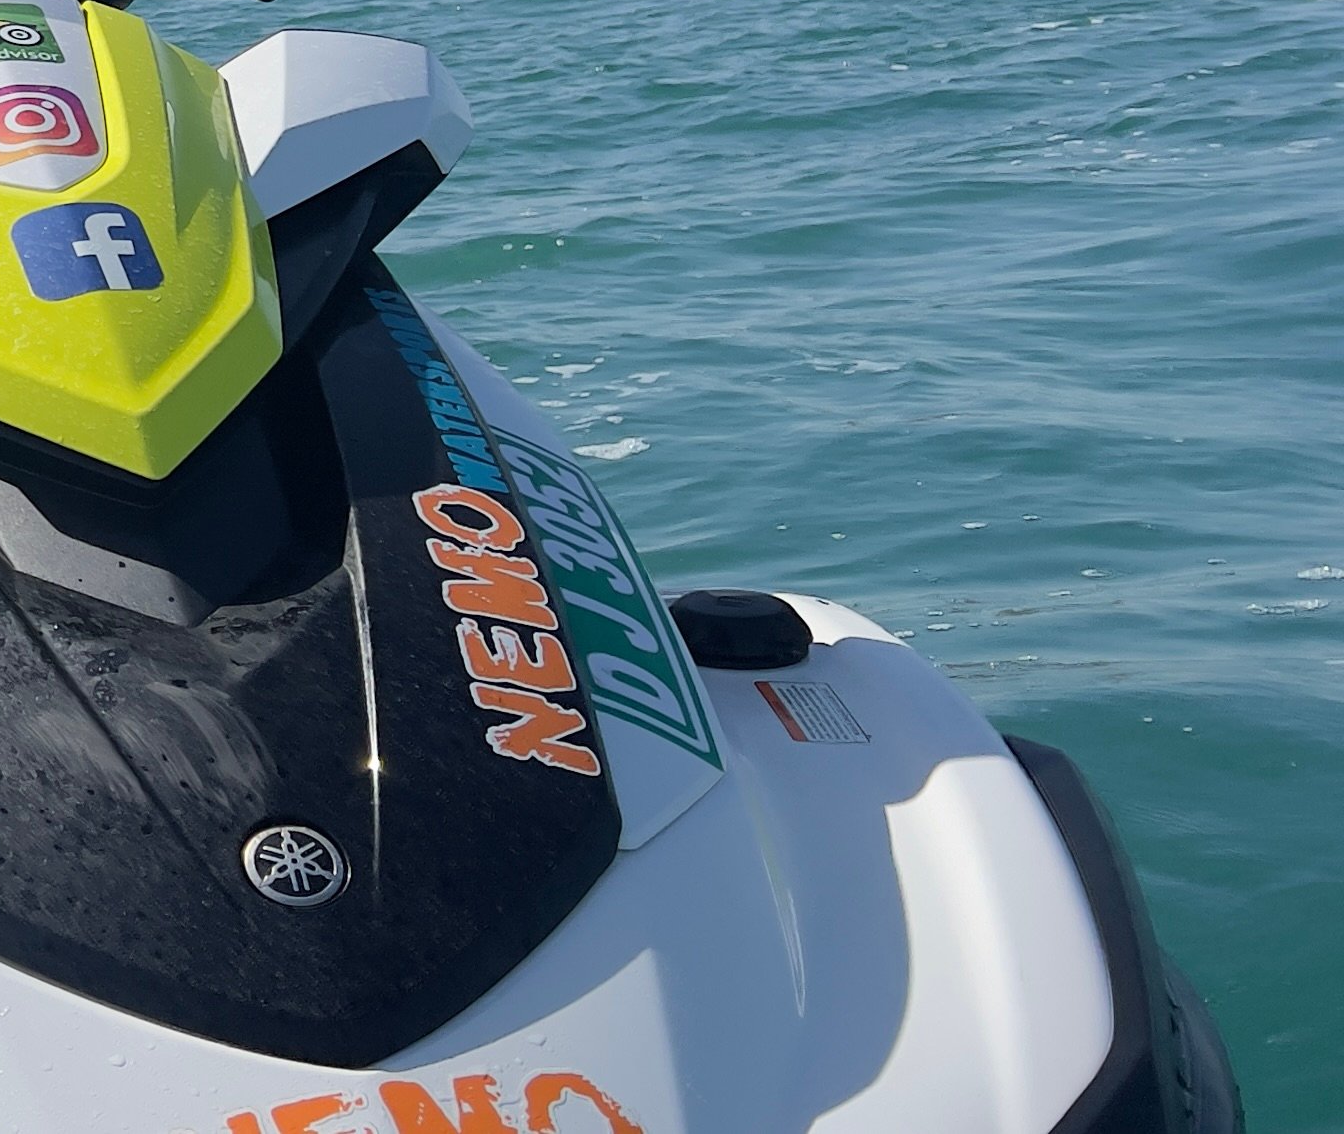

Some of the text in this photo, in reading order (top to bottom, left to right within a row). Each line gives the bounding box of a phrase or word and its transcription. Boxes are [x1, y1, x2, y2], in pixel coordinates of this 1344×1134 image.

[363, 287, 601, 776] NEMO WATERSPORTS
[498, 442, 634, 596] 3052
